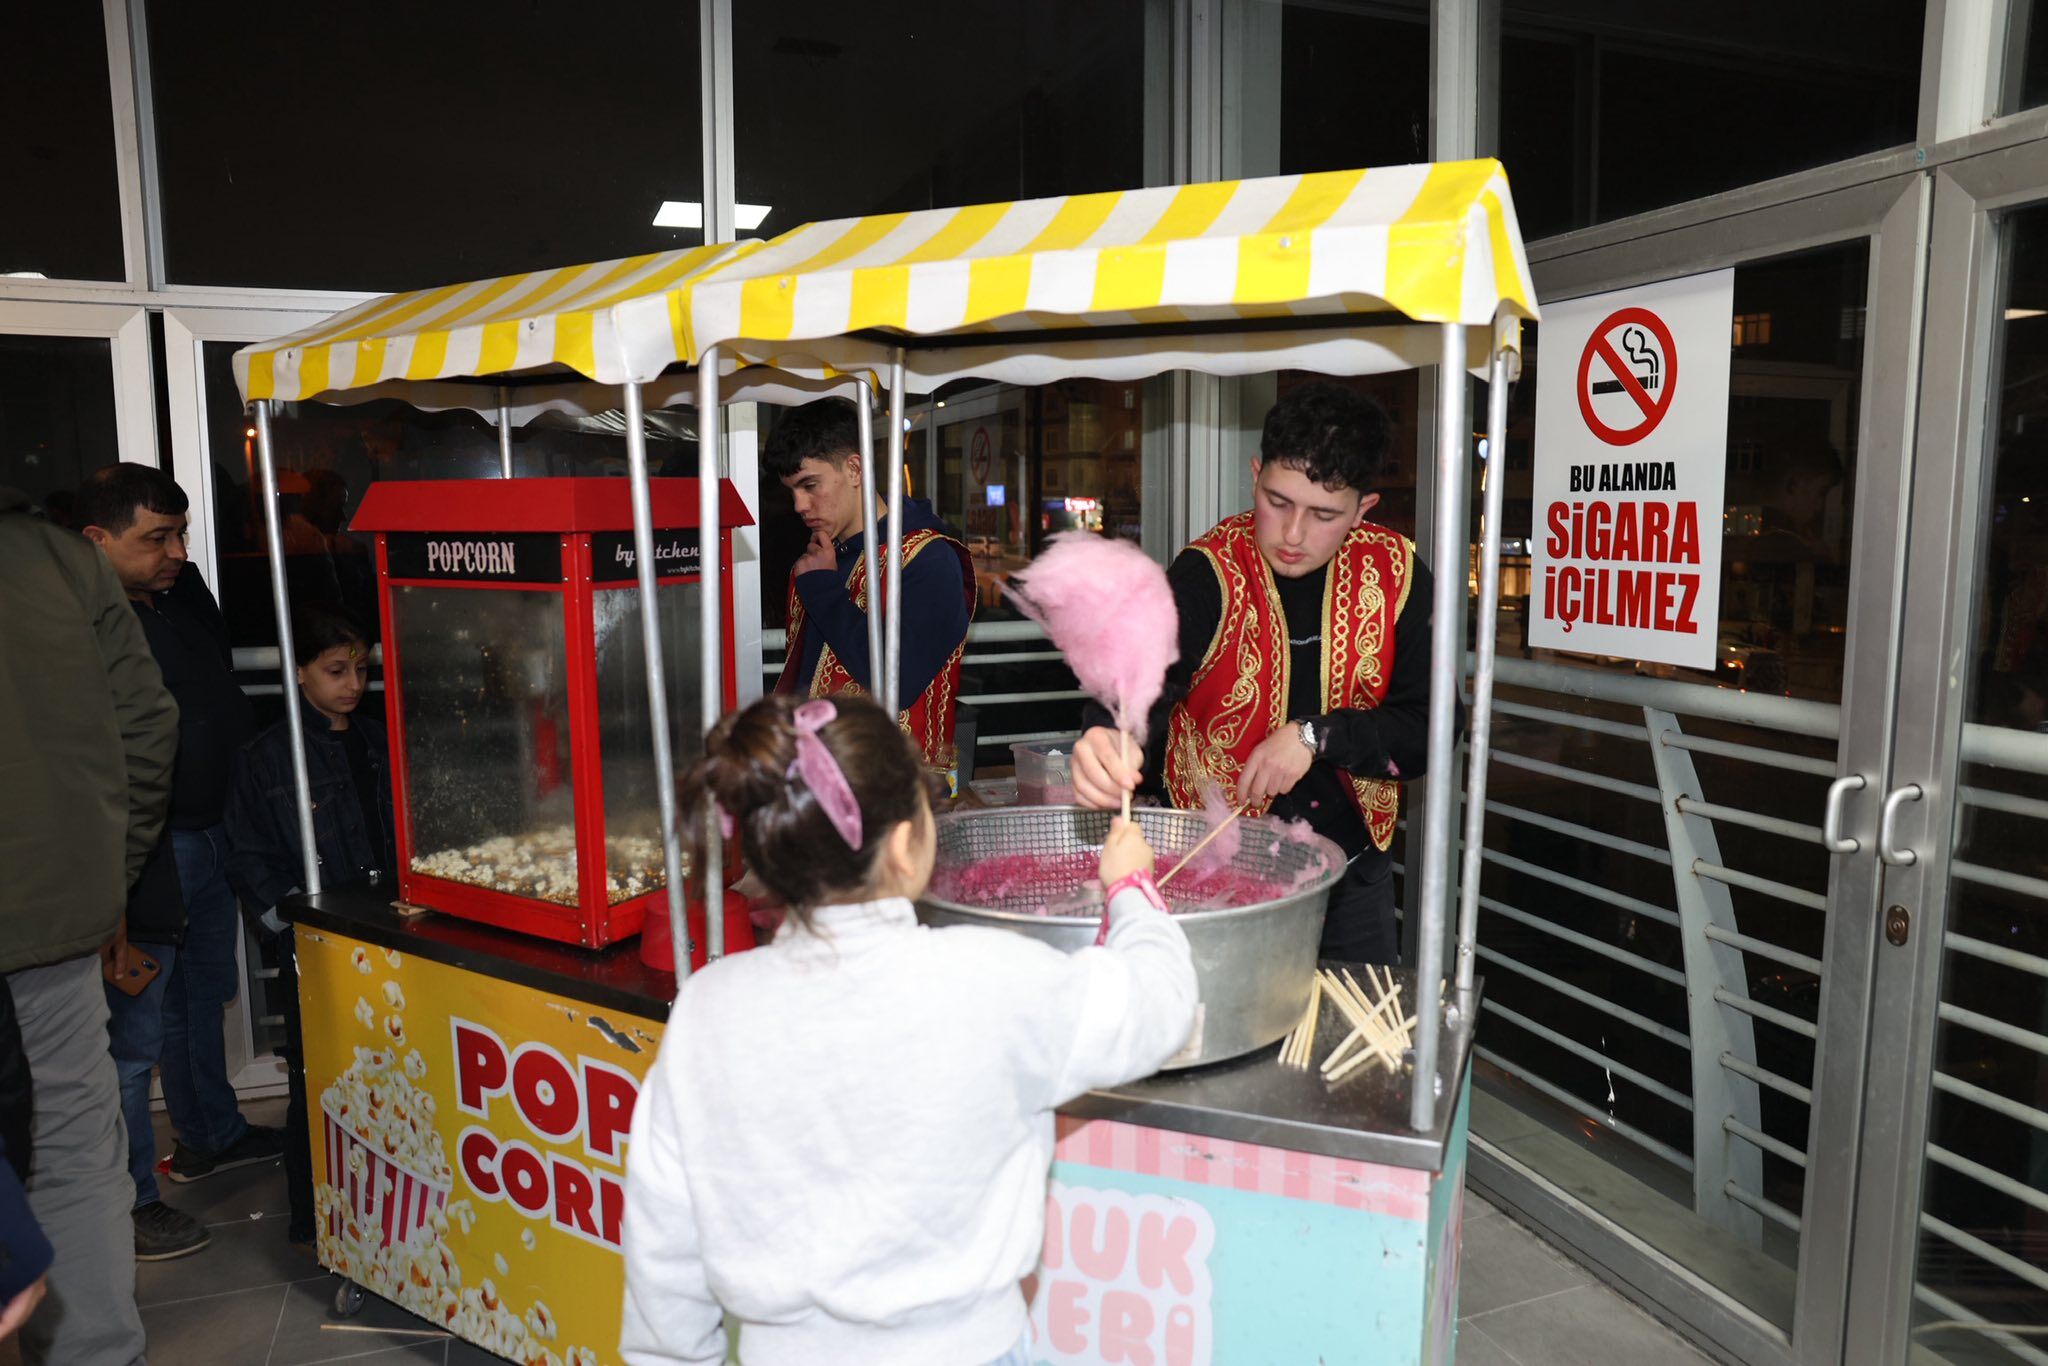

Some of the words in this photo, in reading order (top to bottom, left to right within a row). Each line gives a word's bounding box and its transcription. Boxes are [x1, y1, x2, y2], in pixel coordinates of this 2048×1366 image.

[1570, 464, 1595, 492] BU
[1598, 461, 1676, 492] ALANDA
[427, 541, 516, 575] POPCORN
[1546, 501, 1700, 564] SİGARA
[1544, 566, 1700, 634] İÇİLMEZ
[454, 1022, 639, 1159] POP
